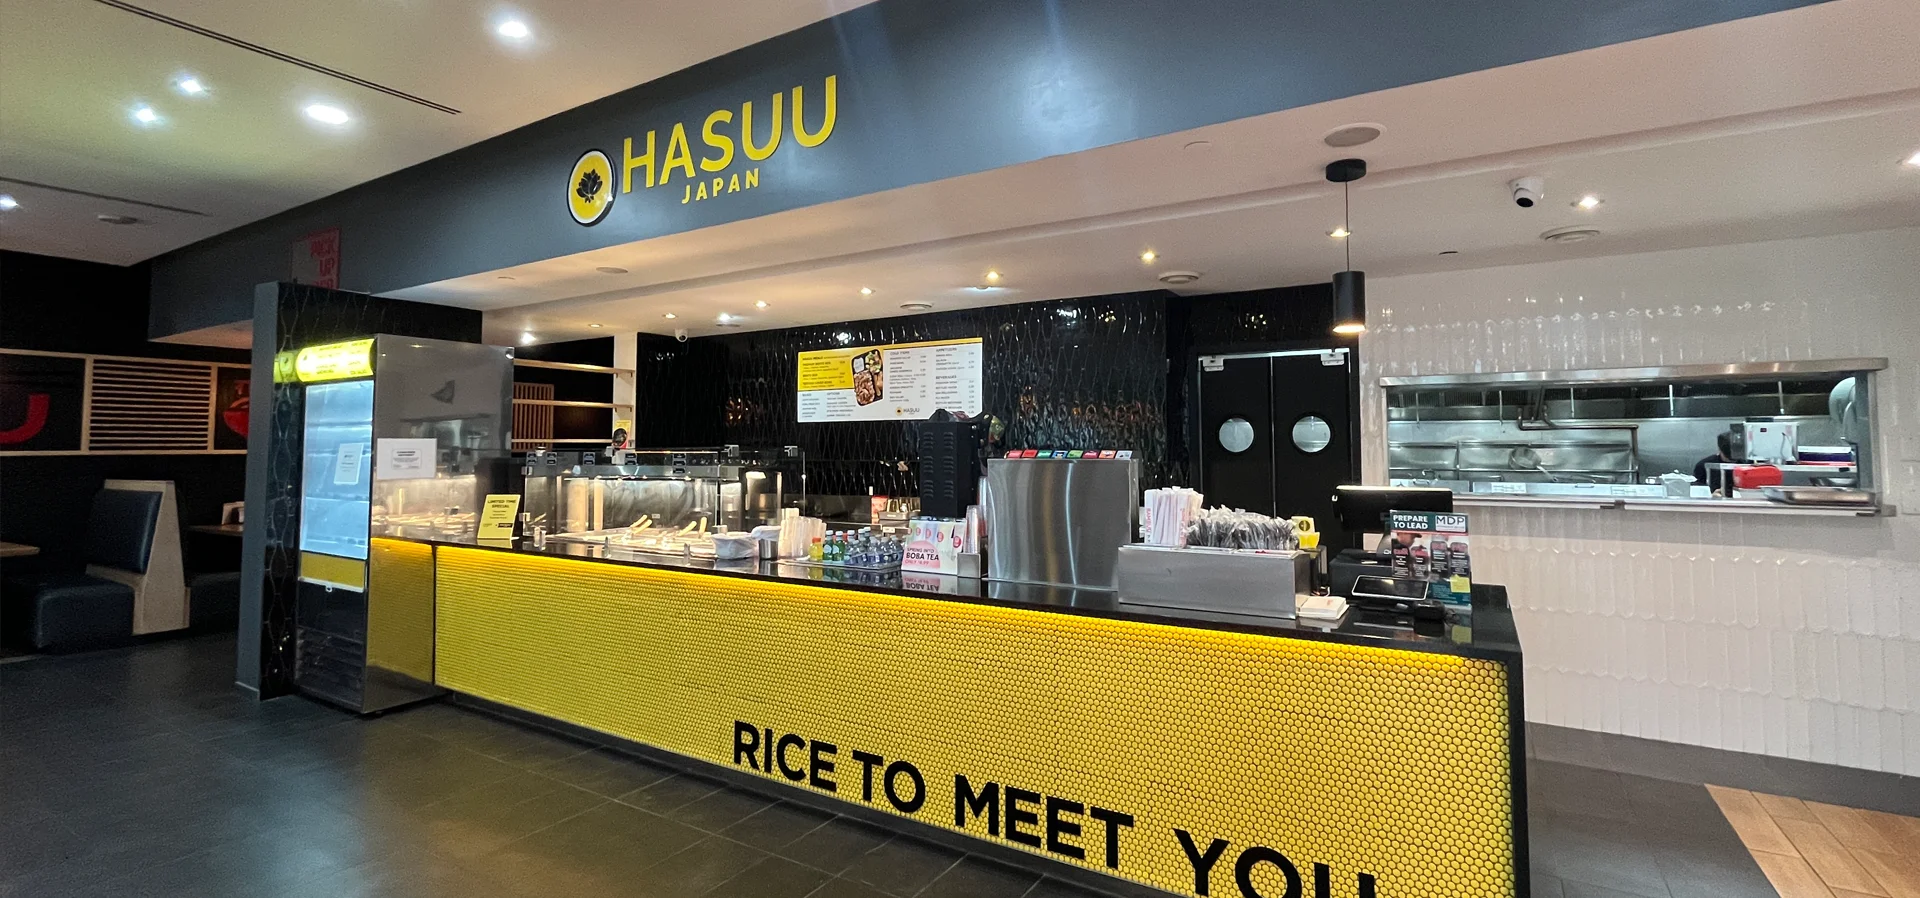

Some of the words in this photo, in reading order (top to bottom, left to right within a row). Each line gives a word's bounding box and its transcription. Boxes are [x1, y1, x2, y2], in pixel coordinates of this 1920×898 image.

[622, 75, 837, 194] HASUU
[681, 168, 759, 205] JAPAN
[319, 258, 335, 277] UP
[1393, 514, 1428, 522] PREPARE
[1436, 516, 1465, 525] MDP
[1393, 521, 1406, 529] TO
[1407, 521, 1428, 529] LEAD
[906, 552, 924, 560] BOBA
[926, 553, 940, 561] TEA
[733, 720, 838, 792] RICE
[852, 750, 926, 813] TO
[954, 773, 1134, 870] MEET
